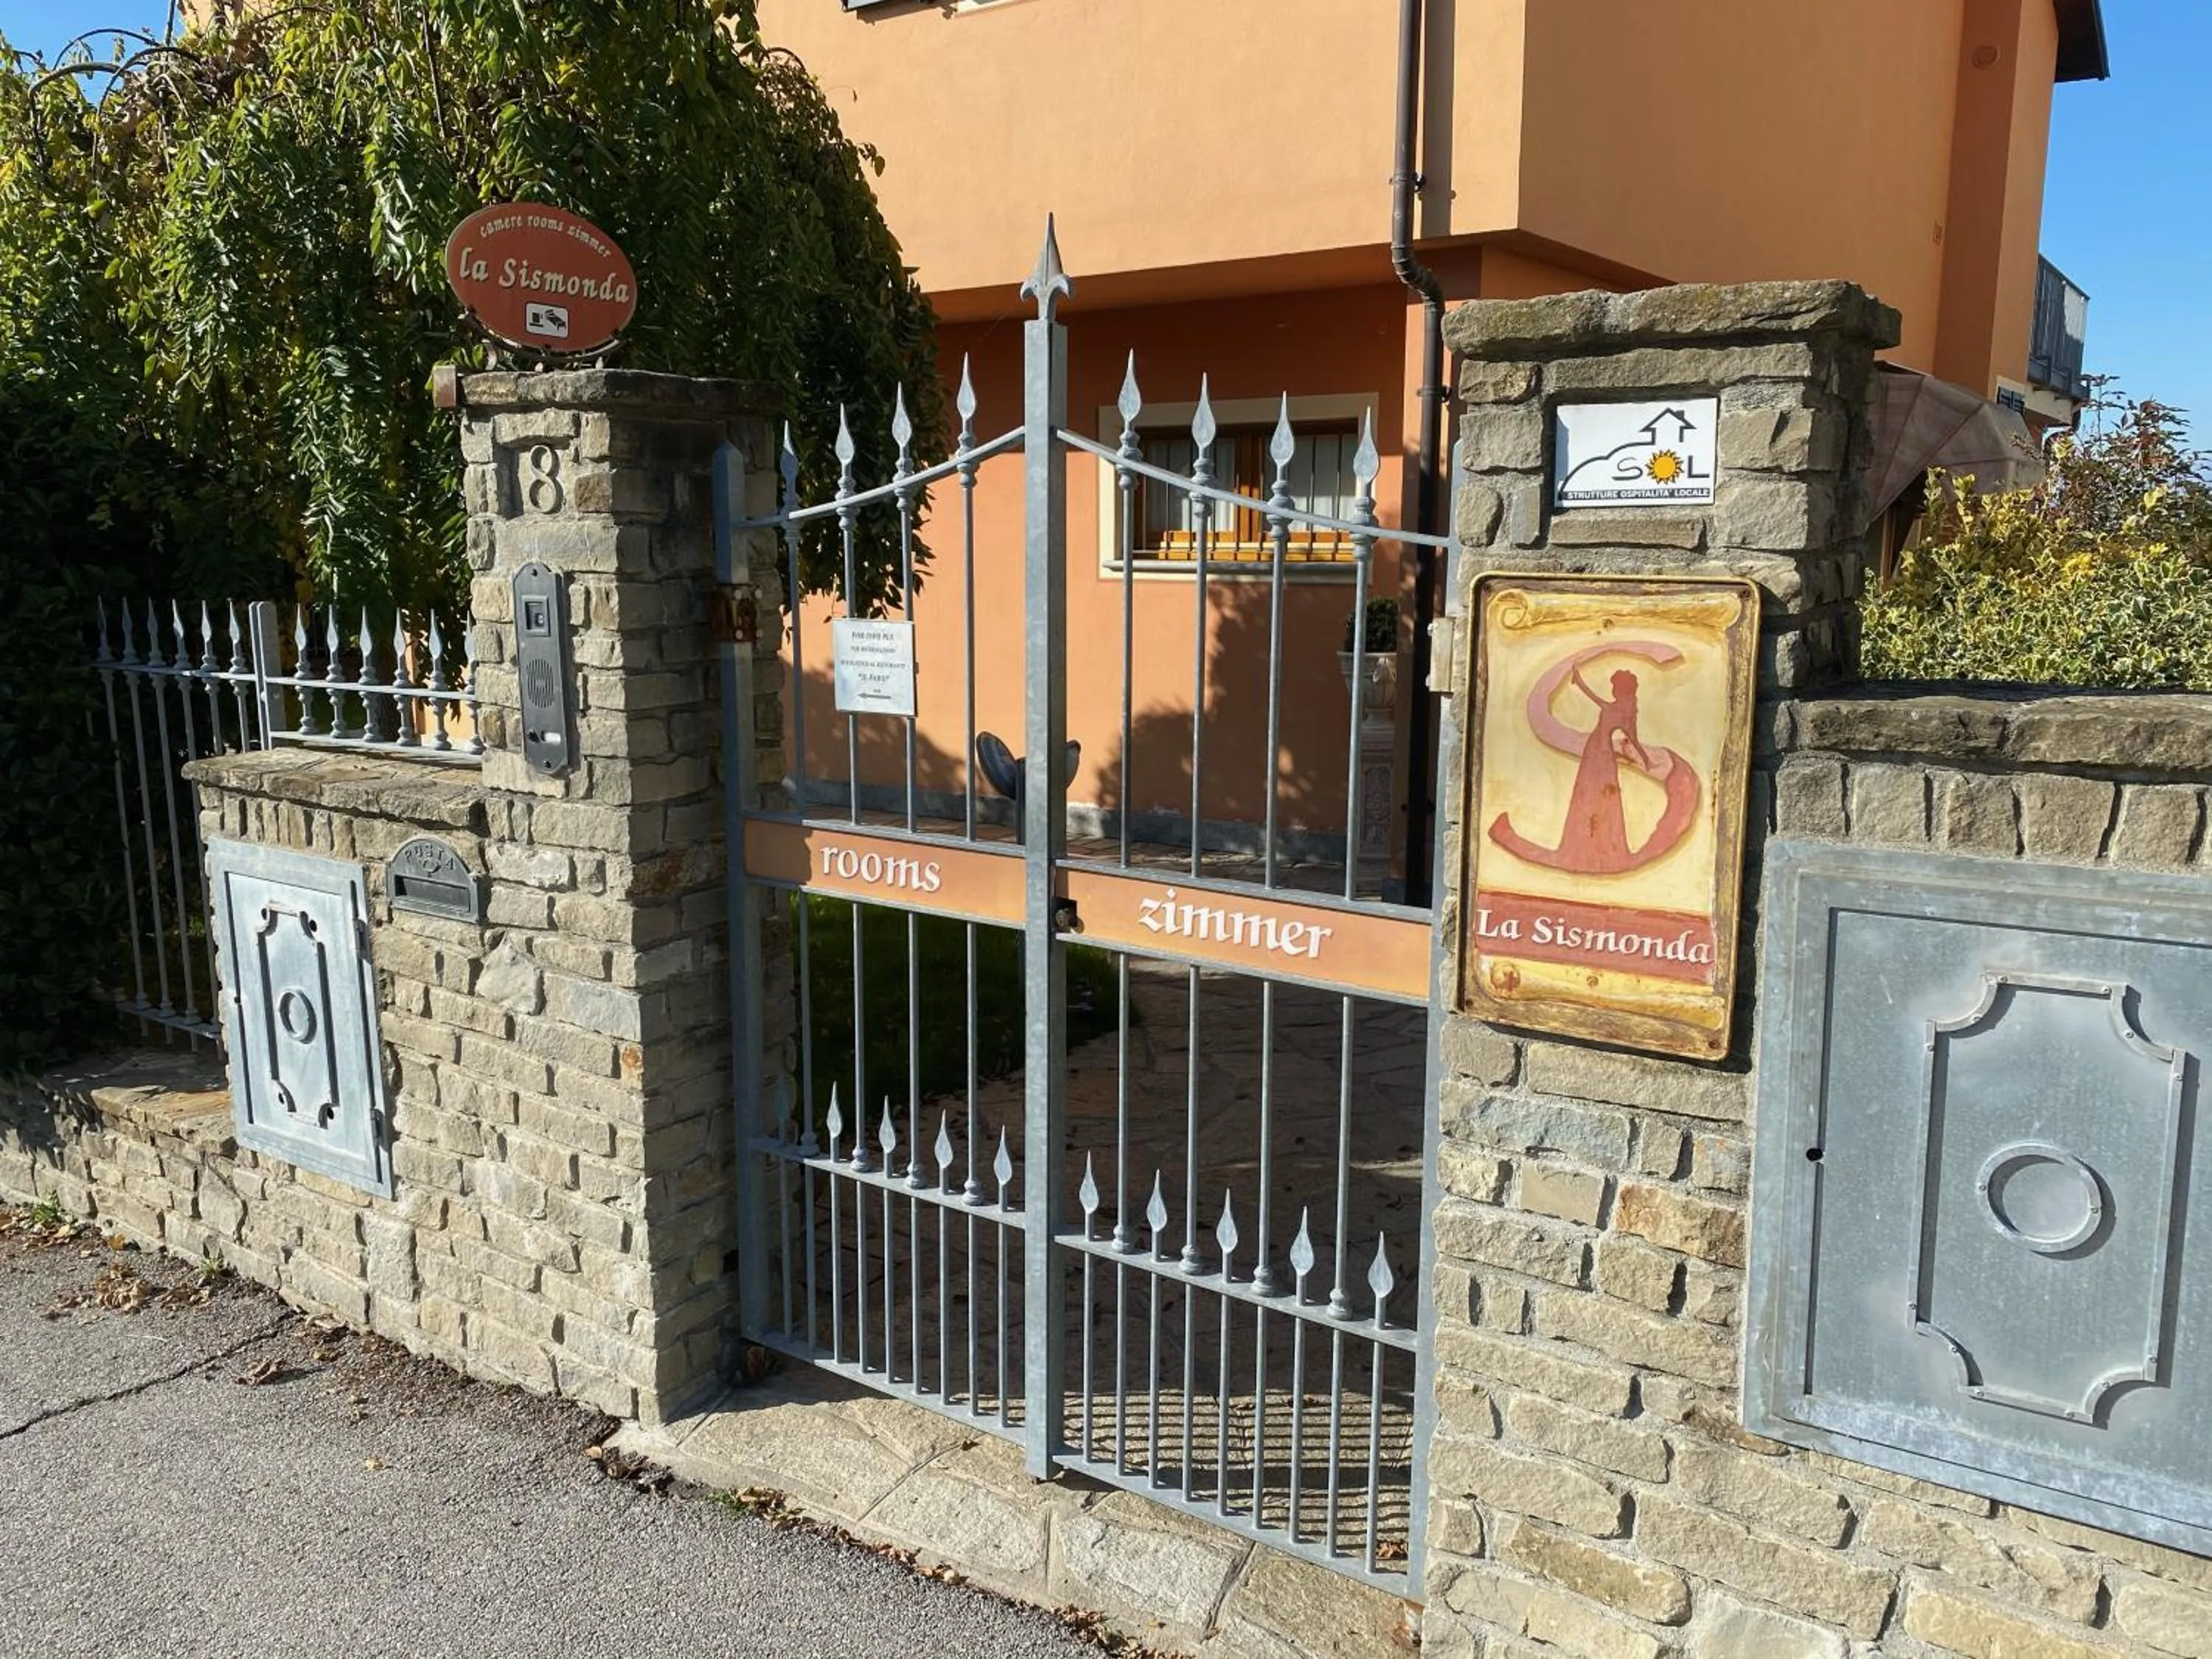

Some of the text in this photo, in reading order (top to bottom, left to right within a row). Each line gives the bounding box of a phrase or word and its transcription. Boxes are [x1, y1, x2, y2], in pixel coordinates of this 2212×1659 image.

[480, 215, 611, 257] camere rooms zimmer
[459, 247, 630, 303] la Sismonda
[529, 445, 564, 515] 8
[1567, 490, 1618, 499] STRUTTURE
[1674, 488, 1708, 497] LOCALE
[404, 843, 454, 871] POSTA
[820, 846, 941, 892] rooms
[1138, 888, 1333, 959] zimmer
[1475, 908, 1714, 964] La Sismonda
